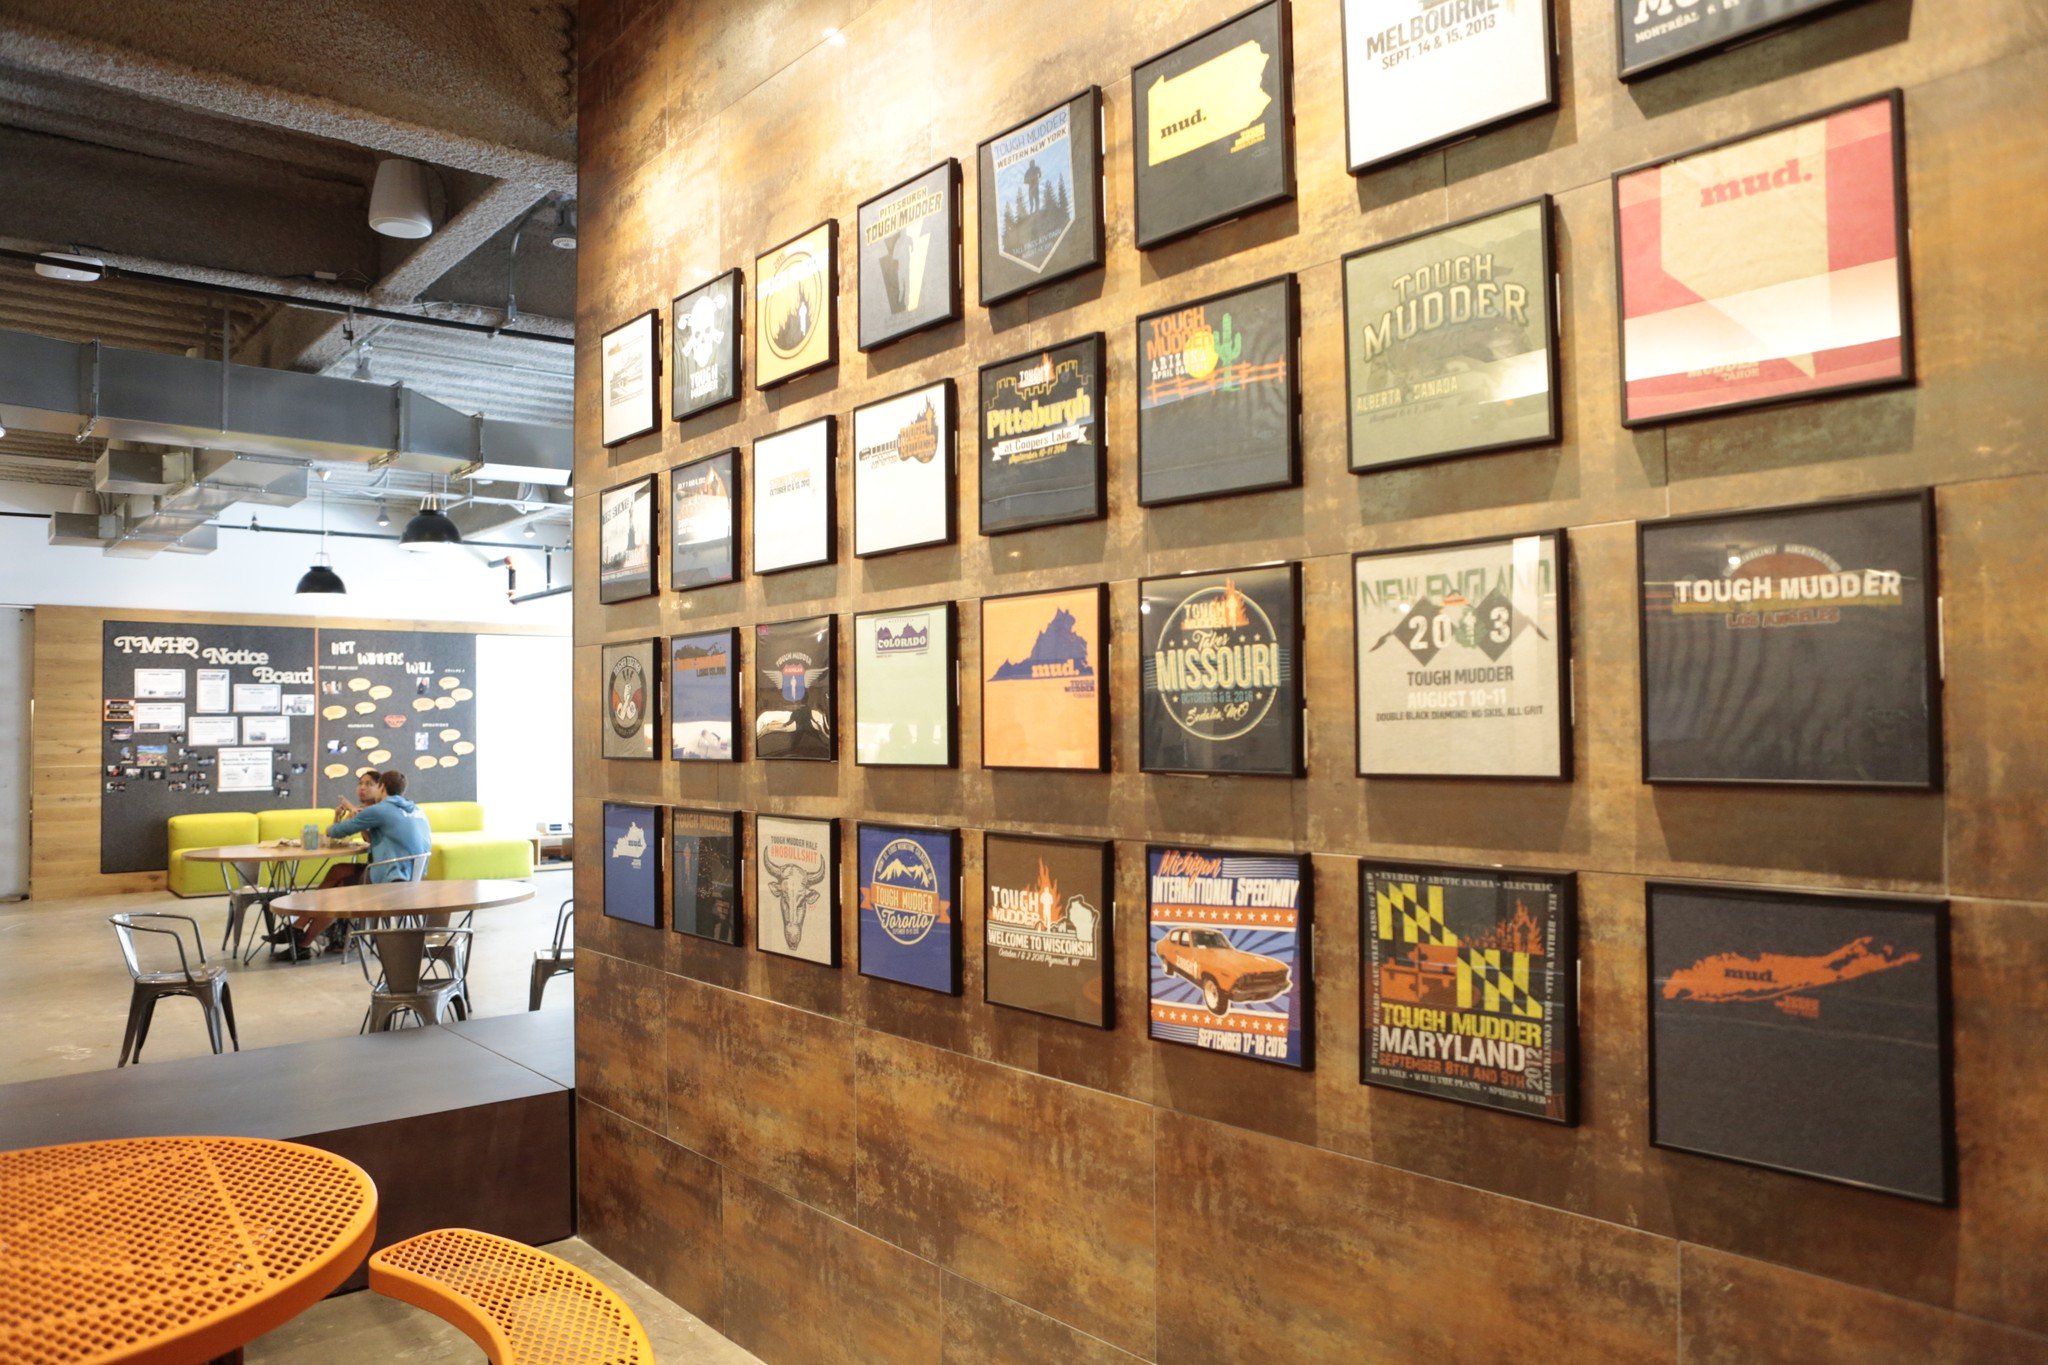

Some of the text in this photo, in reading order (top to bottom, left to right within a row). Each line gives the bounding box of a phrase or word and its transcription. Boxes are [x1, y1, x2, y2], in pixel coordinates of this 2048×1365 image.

[1382, 14, 1496, 70] SEPT. 14 & 15, 2013
[994, 112, 1067, 157] TOUGH MUDDER
[1160, 109, 1207, 140] mud.
[998, 129, 1067, 169] WESTERN NEW YORK
[1701, 158, 1813, 208] mud.
[879, 187, 928, 218] PITTSBURGH
[866, 192, 943, 244] TOUGH MUDDER
[1393, 254, 1493, 301] TOUGH
[1151, 306, 1205, 336] TOUGH
[1363, 283, 1529, 363] MUDDER
[1146, 325, 1213, 361] MUDDER
[690, 363, 718, 389] TOUGH
[1357, 388, 1402, 413] ALBERTA
[1413, 376, 1458, 399] CANADA
[1004, 428, 1072, 453] at Coopers Lake
[1361, 577, 1418, 611] NEW
[1675, 570, 1901, 603] TOUGH MUDDER
[1184, 601, 1226, 620] TOUGH
[1727, 607, 1840, 630] LOS ANGELES
[114, 636, 200, 659] TMHQ
[878, 636, 926, 648] COLORADO
[1192, 629, 1230, 650] Takes
[202, 648, 269, 665] Notice
[776, 652, 792, 668] TOUGH
[1032, 659, 1080, 678] mud.
[1155, 643, 1280, 691] MISSOURI
[252, 666, 315, 684] Board
[1407, 665, 1514, 687] TOUGH MUDDER
[1181, 692, 1211, 704] OCTOBER
[1407, 687, 1507, 709] AUGUST 10-11
[1376, 712, 1404, 722] DOUBLE
[1406, 711, 1429, 721] BLACK
[1472, 709, 1483, 719] NO
[1507, 706, 1522, 717] ALL
[1524, 705, 1543, 716] GRIT
[675, 813, 730, 833] TOUGH MUDDER
[771, 836, 785, 845] TOUGH
[786, 837, 805, 848] MUDDER
[1158, 850, 1222, 888] Michigan
[1381, 872, 1553, 892] EVEREST ARCTIC ENEMA ELECTRIC
[876, 886, 933, 914] TOUGH MUDDER
[991, 885, 1039, 912] TOUGH
[1152, 875, 1300, 908] INTERNATIONAL SPEEDWAY
[881, 908, 930, 930] Toronto
[992, 906, 1040, 927] MUDDER
[1369, 910, 1378, 931] KISS
[988, 928, 1093, 957] WELCOME TO WISCONSIN
[1371, 938, 1379, 986] GAUNTLET
[1723, 967, 1778, 984] mud.
[1544, 893, 1557, 1096] EEL BERLIN WALLS BOA CONSTRICTOR
[1381, 1003, 1542, 1047] TOUGH MUDDER
[1198, 1028, 1242, 1053] SEPTEMBER
[1243, 1034, 1265, 1056] 17-18
[1379, 1025, 1526, 1072] MARYLAND
[1379, 1052, 1441, 1075] SEPTEMBER
[1473, 1066, 1497, 1083] AND
[1501, 1071, 1526, 1089] 9TH
[1525, 1048, 1543, 1091] 2012
